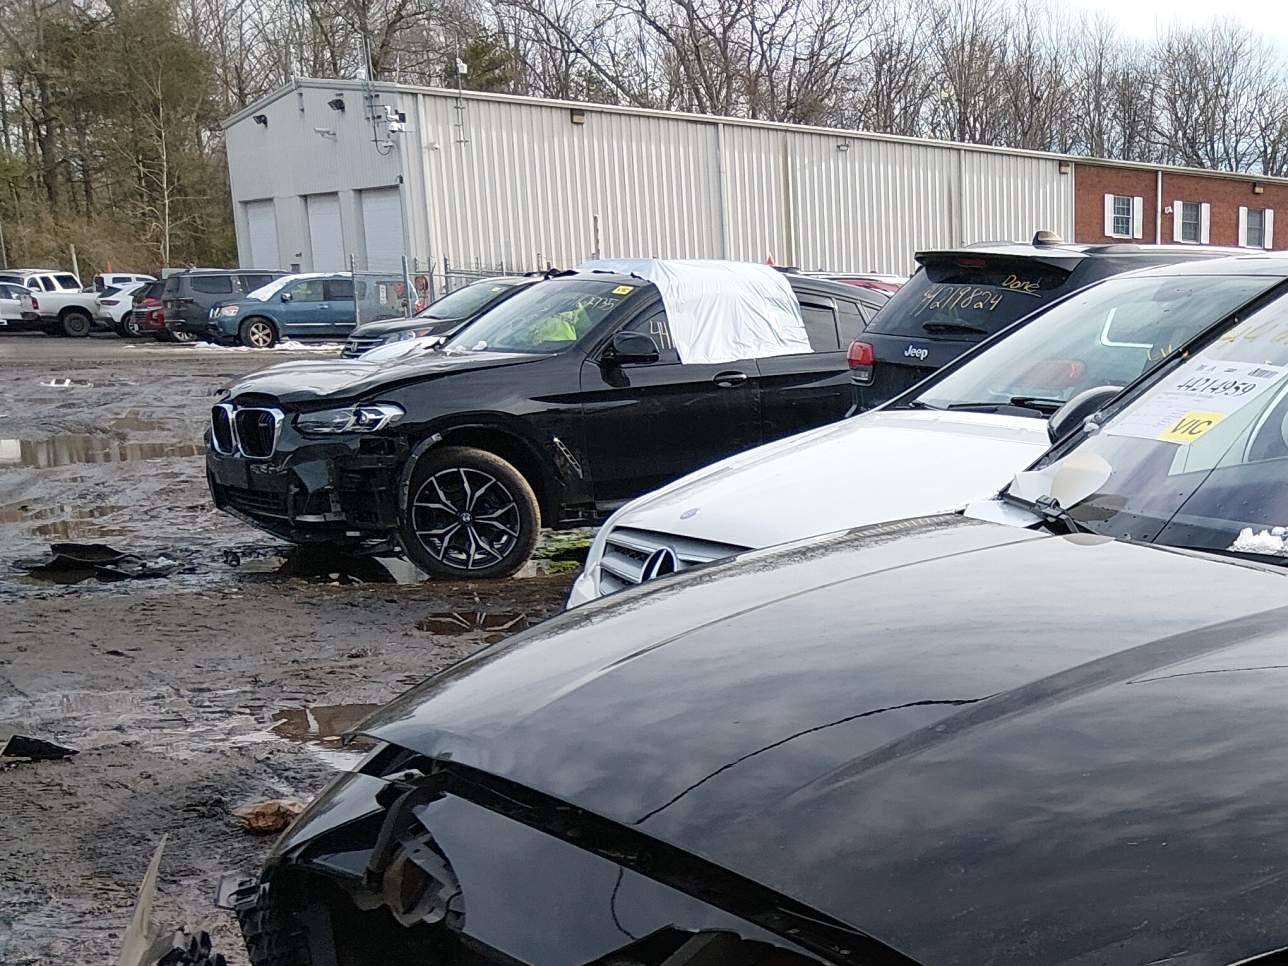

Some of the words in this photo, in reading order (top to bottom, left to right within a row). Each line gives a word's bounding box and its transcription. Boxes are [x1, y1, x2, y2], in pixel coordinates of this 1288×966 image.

[904, 345, 929, 360] Jeep
[1176, 375, 1257, 398] 44214959
[1170, 417, 1213, 436] VIC
